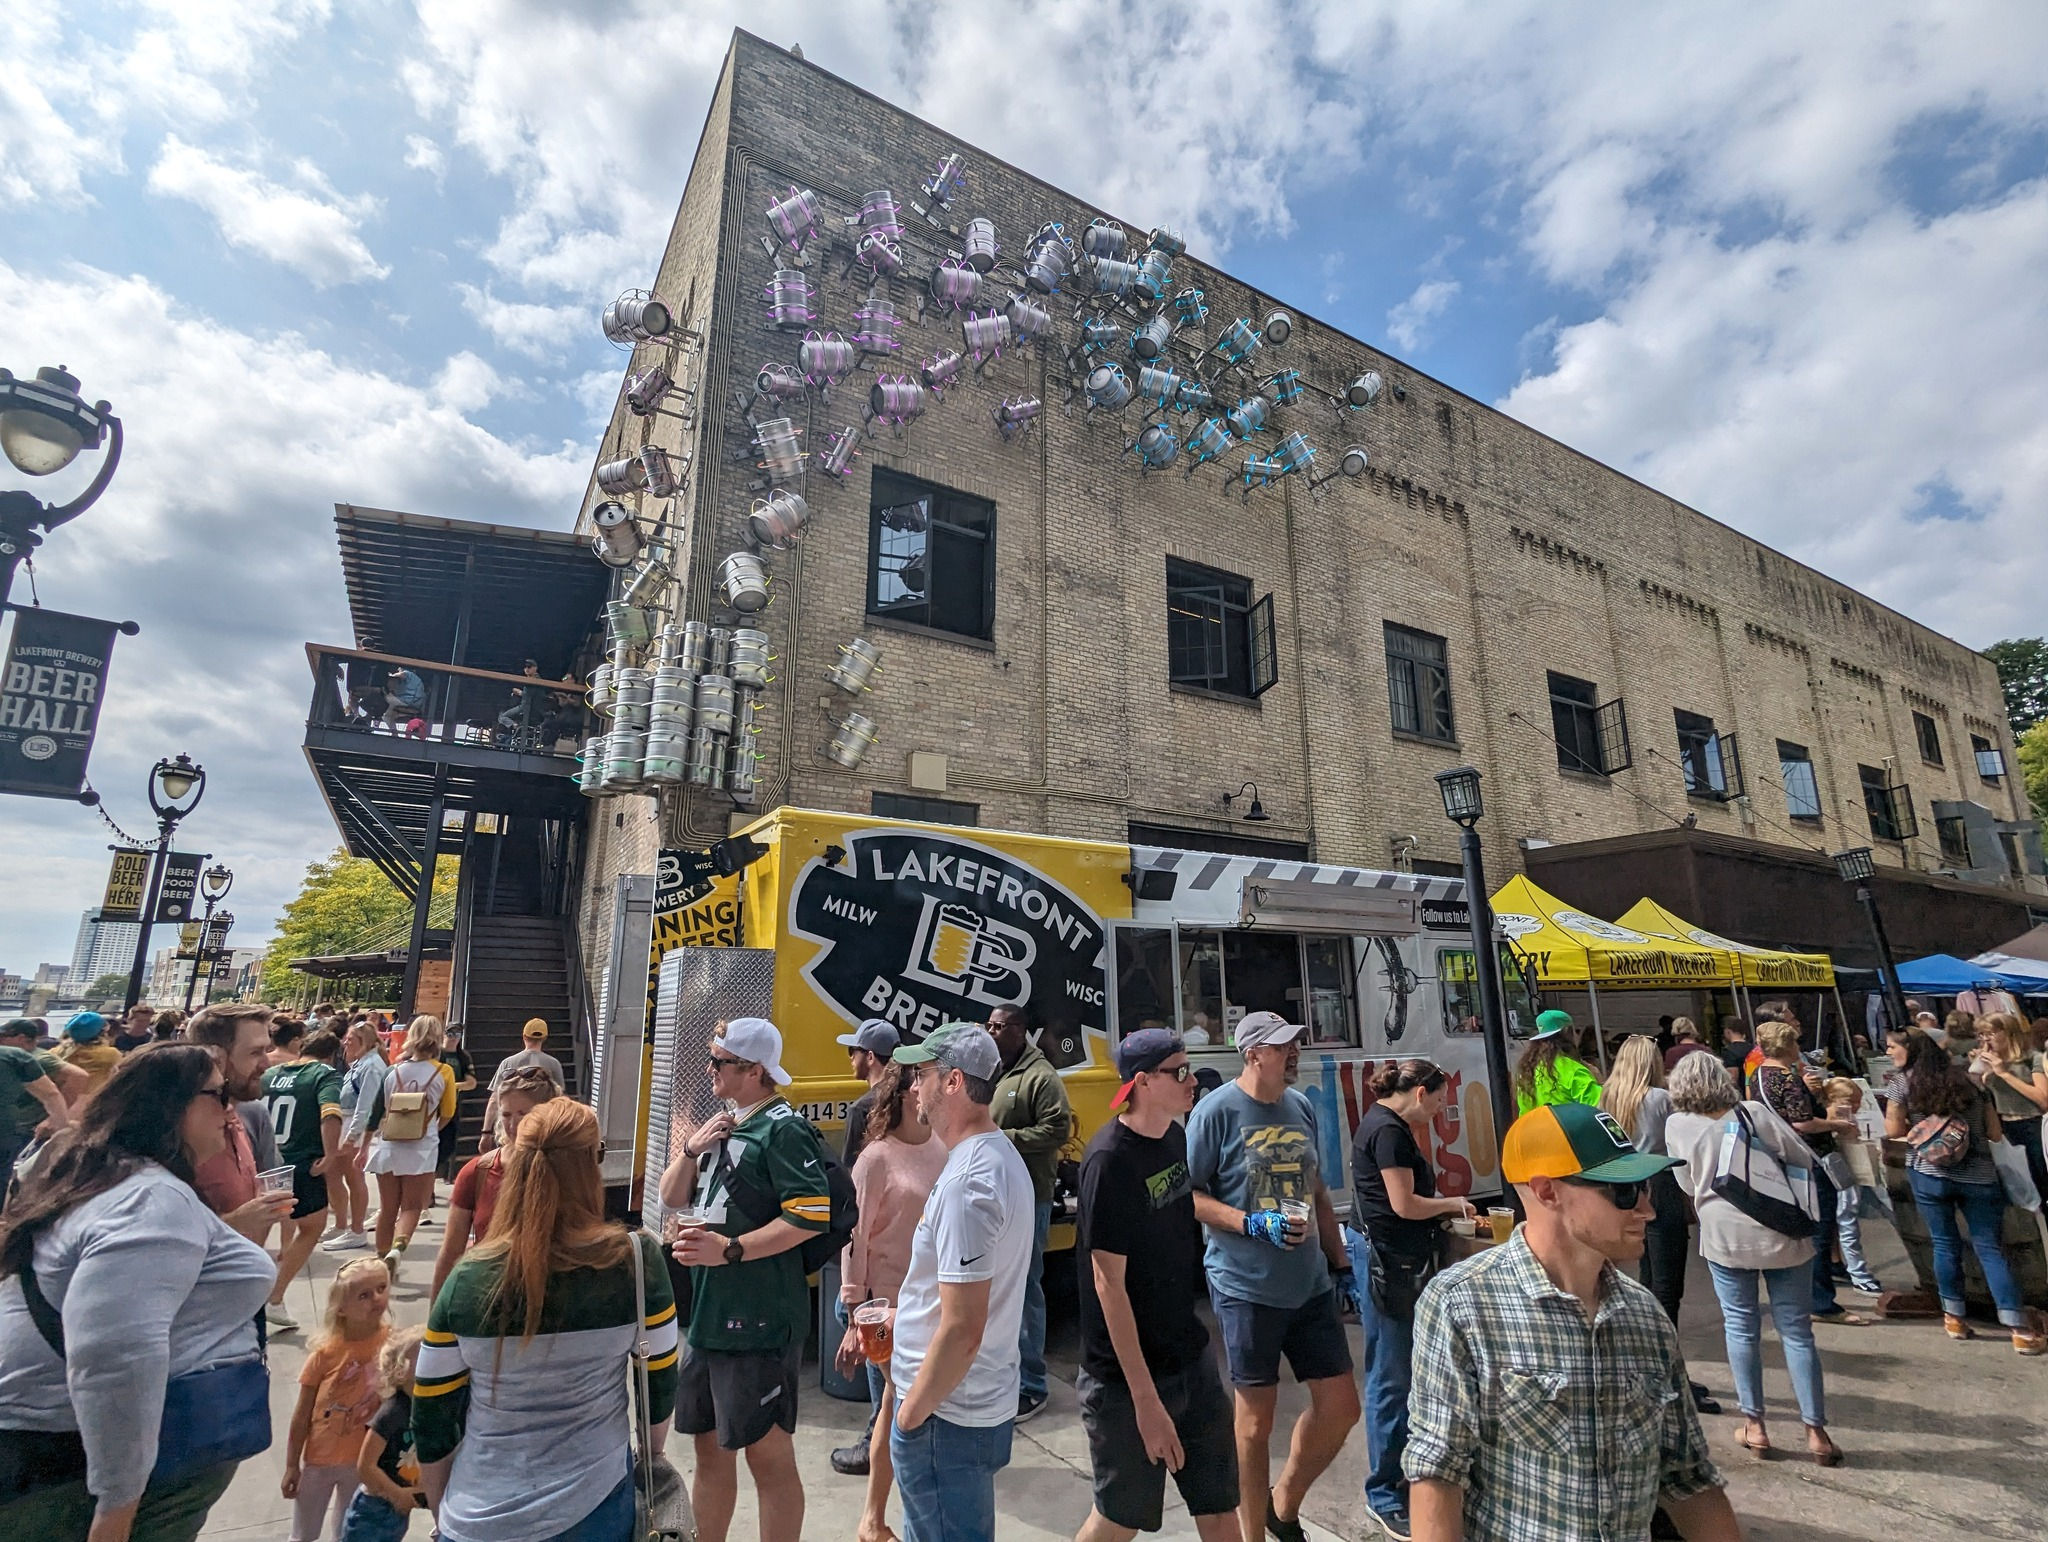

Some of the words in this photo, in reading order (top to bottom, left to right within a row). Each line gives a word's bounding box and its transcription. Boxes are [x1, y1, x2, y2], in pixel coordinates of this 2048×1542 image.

[15, 647, 64, 658] LAKEFRONT
[66, 652, 103, 668] BREWERY
[4, 661, 98, 703] BEER
[0, 695, 91, 735] HALL
[116, 856, 147, 871] COLD
[695, 862, 713, 870] WISC
[112, 871, 144, 886] BEER
[167, 868, 197, 877] BEER.
[164, 879, 195, 888] FOOD.
[107, 890, 141, 905] HERE
[162, 890, 193, 899] BEER.
[872, 849, 1092, 951] LAKEFRONT
[822, 895, 878, 926] MILW
[1422, 909, 1443, 923] Follow
[1444, 911, 1453, 923] us
[1453, 911, 1461, 923] to
[208, 932, 225, 940] BEER
[1604, 950, 1669, 975] LAKEFRONT
[1671, 952, 1718, 976] BREWERY
[1755, 958, 1795, 981] LAKEFRONT
[1066, 979, 1104, 1006] WISC
[799, 1102, 834, 1122] 414
